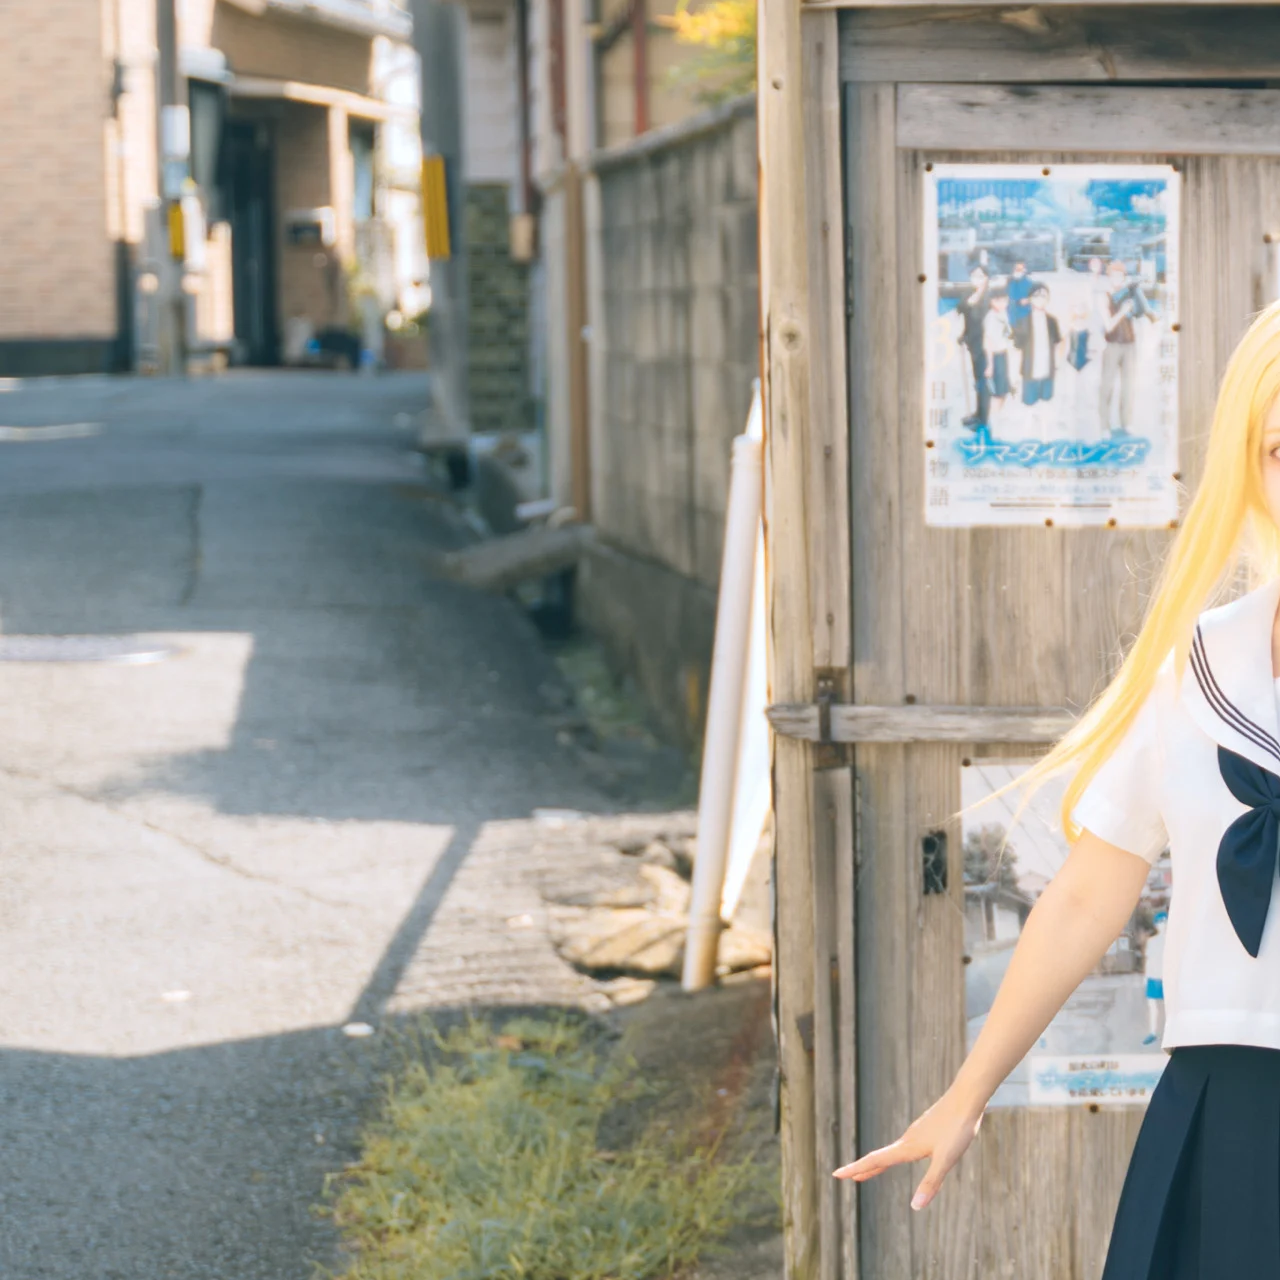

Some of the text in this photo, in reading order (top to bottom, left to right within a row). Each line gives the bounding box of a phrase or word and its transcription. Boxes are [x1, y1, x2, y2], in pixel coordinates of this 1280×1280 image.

[959, 427, 1147, 462] サマータイムレンダ
